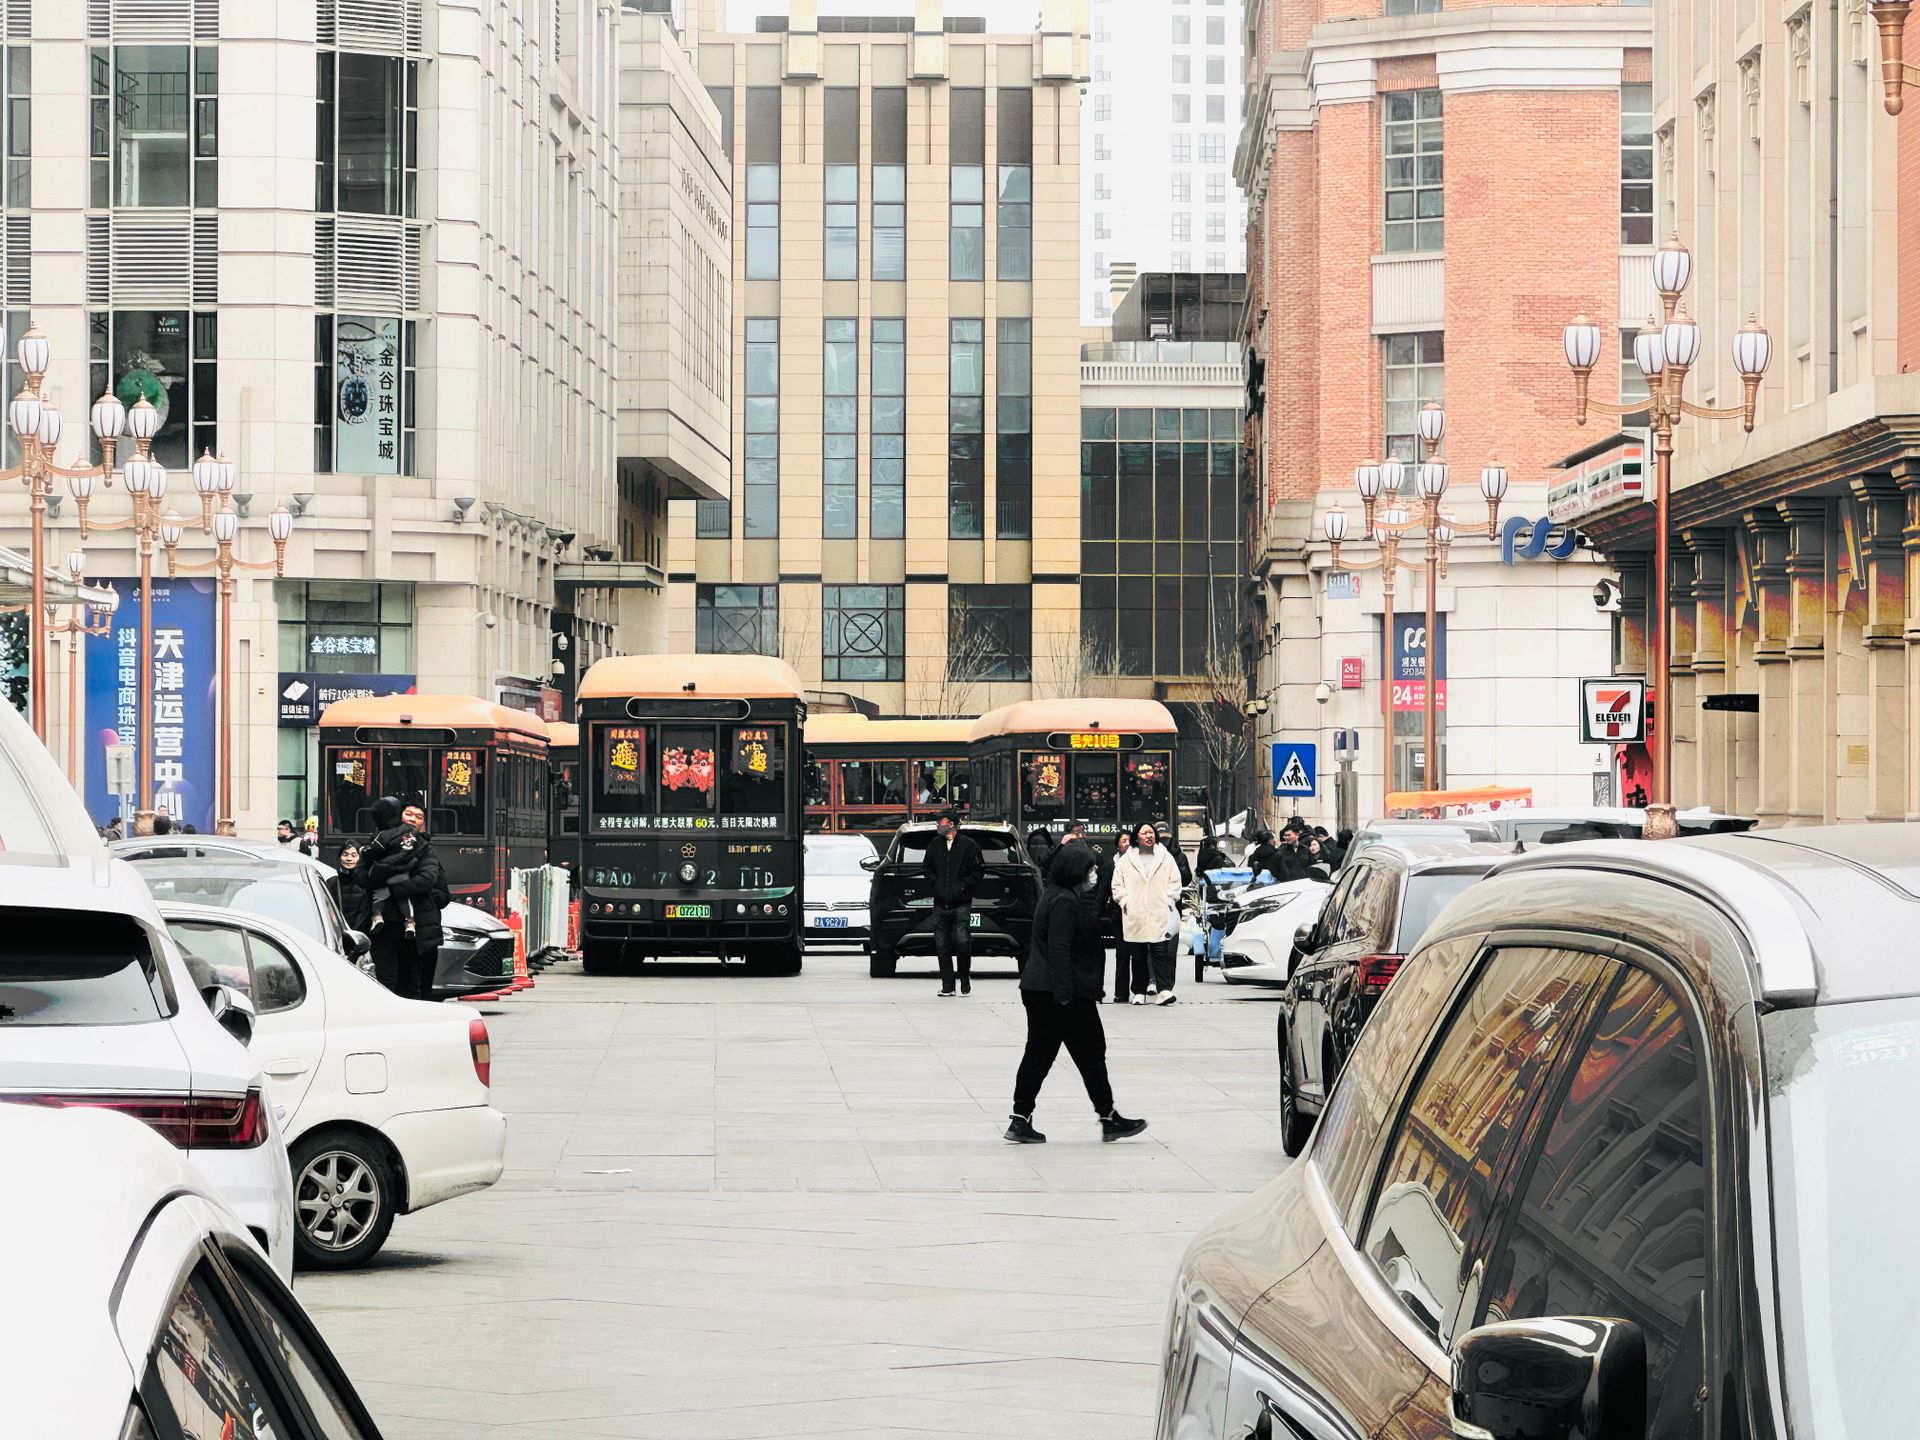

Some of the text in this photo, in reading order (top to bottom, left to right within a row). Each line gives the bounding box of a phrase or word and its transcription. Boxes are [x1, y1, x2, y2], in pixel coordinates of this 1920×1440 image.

[378, 348, 395, 460] 金谷珠宝城
[310, 635, 376, 654] 金谷珠宝城
[1393, 685, 1412, 705] 24
[1596, 690, 1631, 737] 7
[154, 629, 184, 821] 天津运营中心
